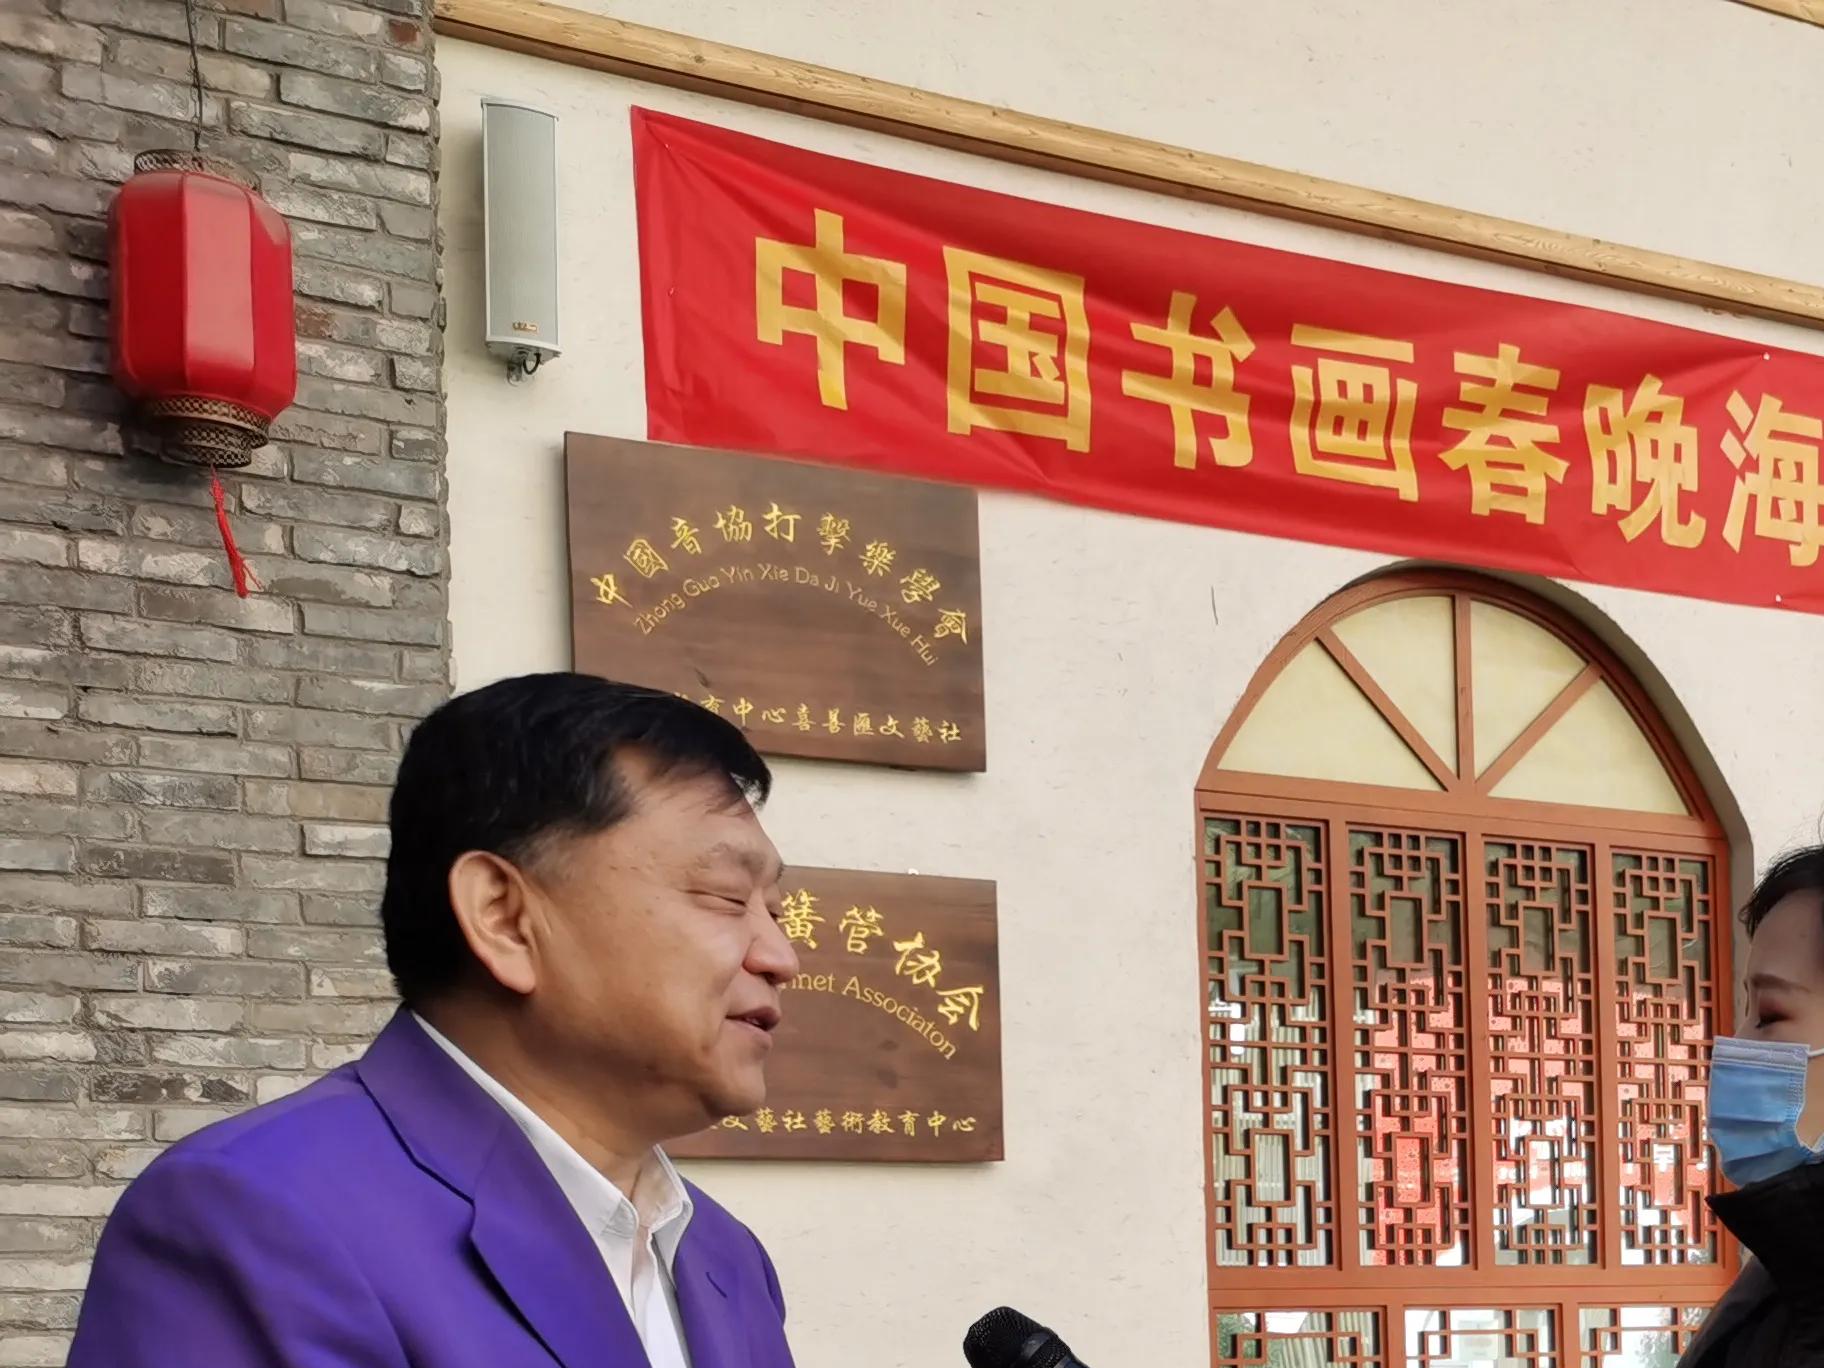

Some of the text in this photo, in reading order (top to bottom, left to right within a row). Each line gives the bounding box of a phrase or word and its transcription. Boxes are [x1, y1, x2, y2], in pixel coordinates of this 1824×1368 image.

[634, 562, 939, 667] Zhong Guo Yin Xie Da Ji Yue Xue Hui
[841, 975, 958, 1060] Associaton
